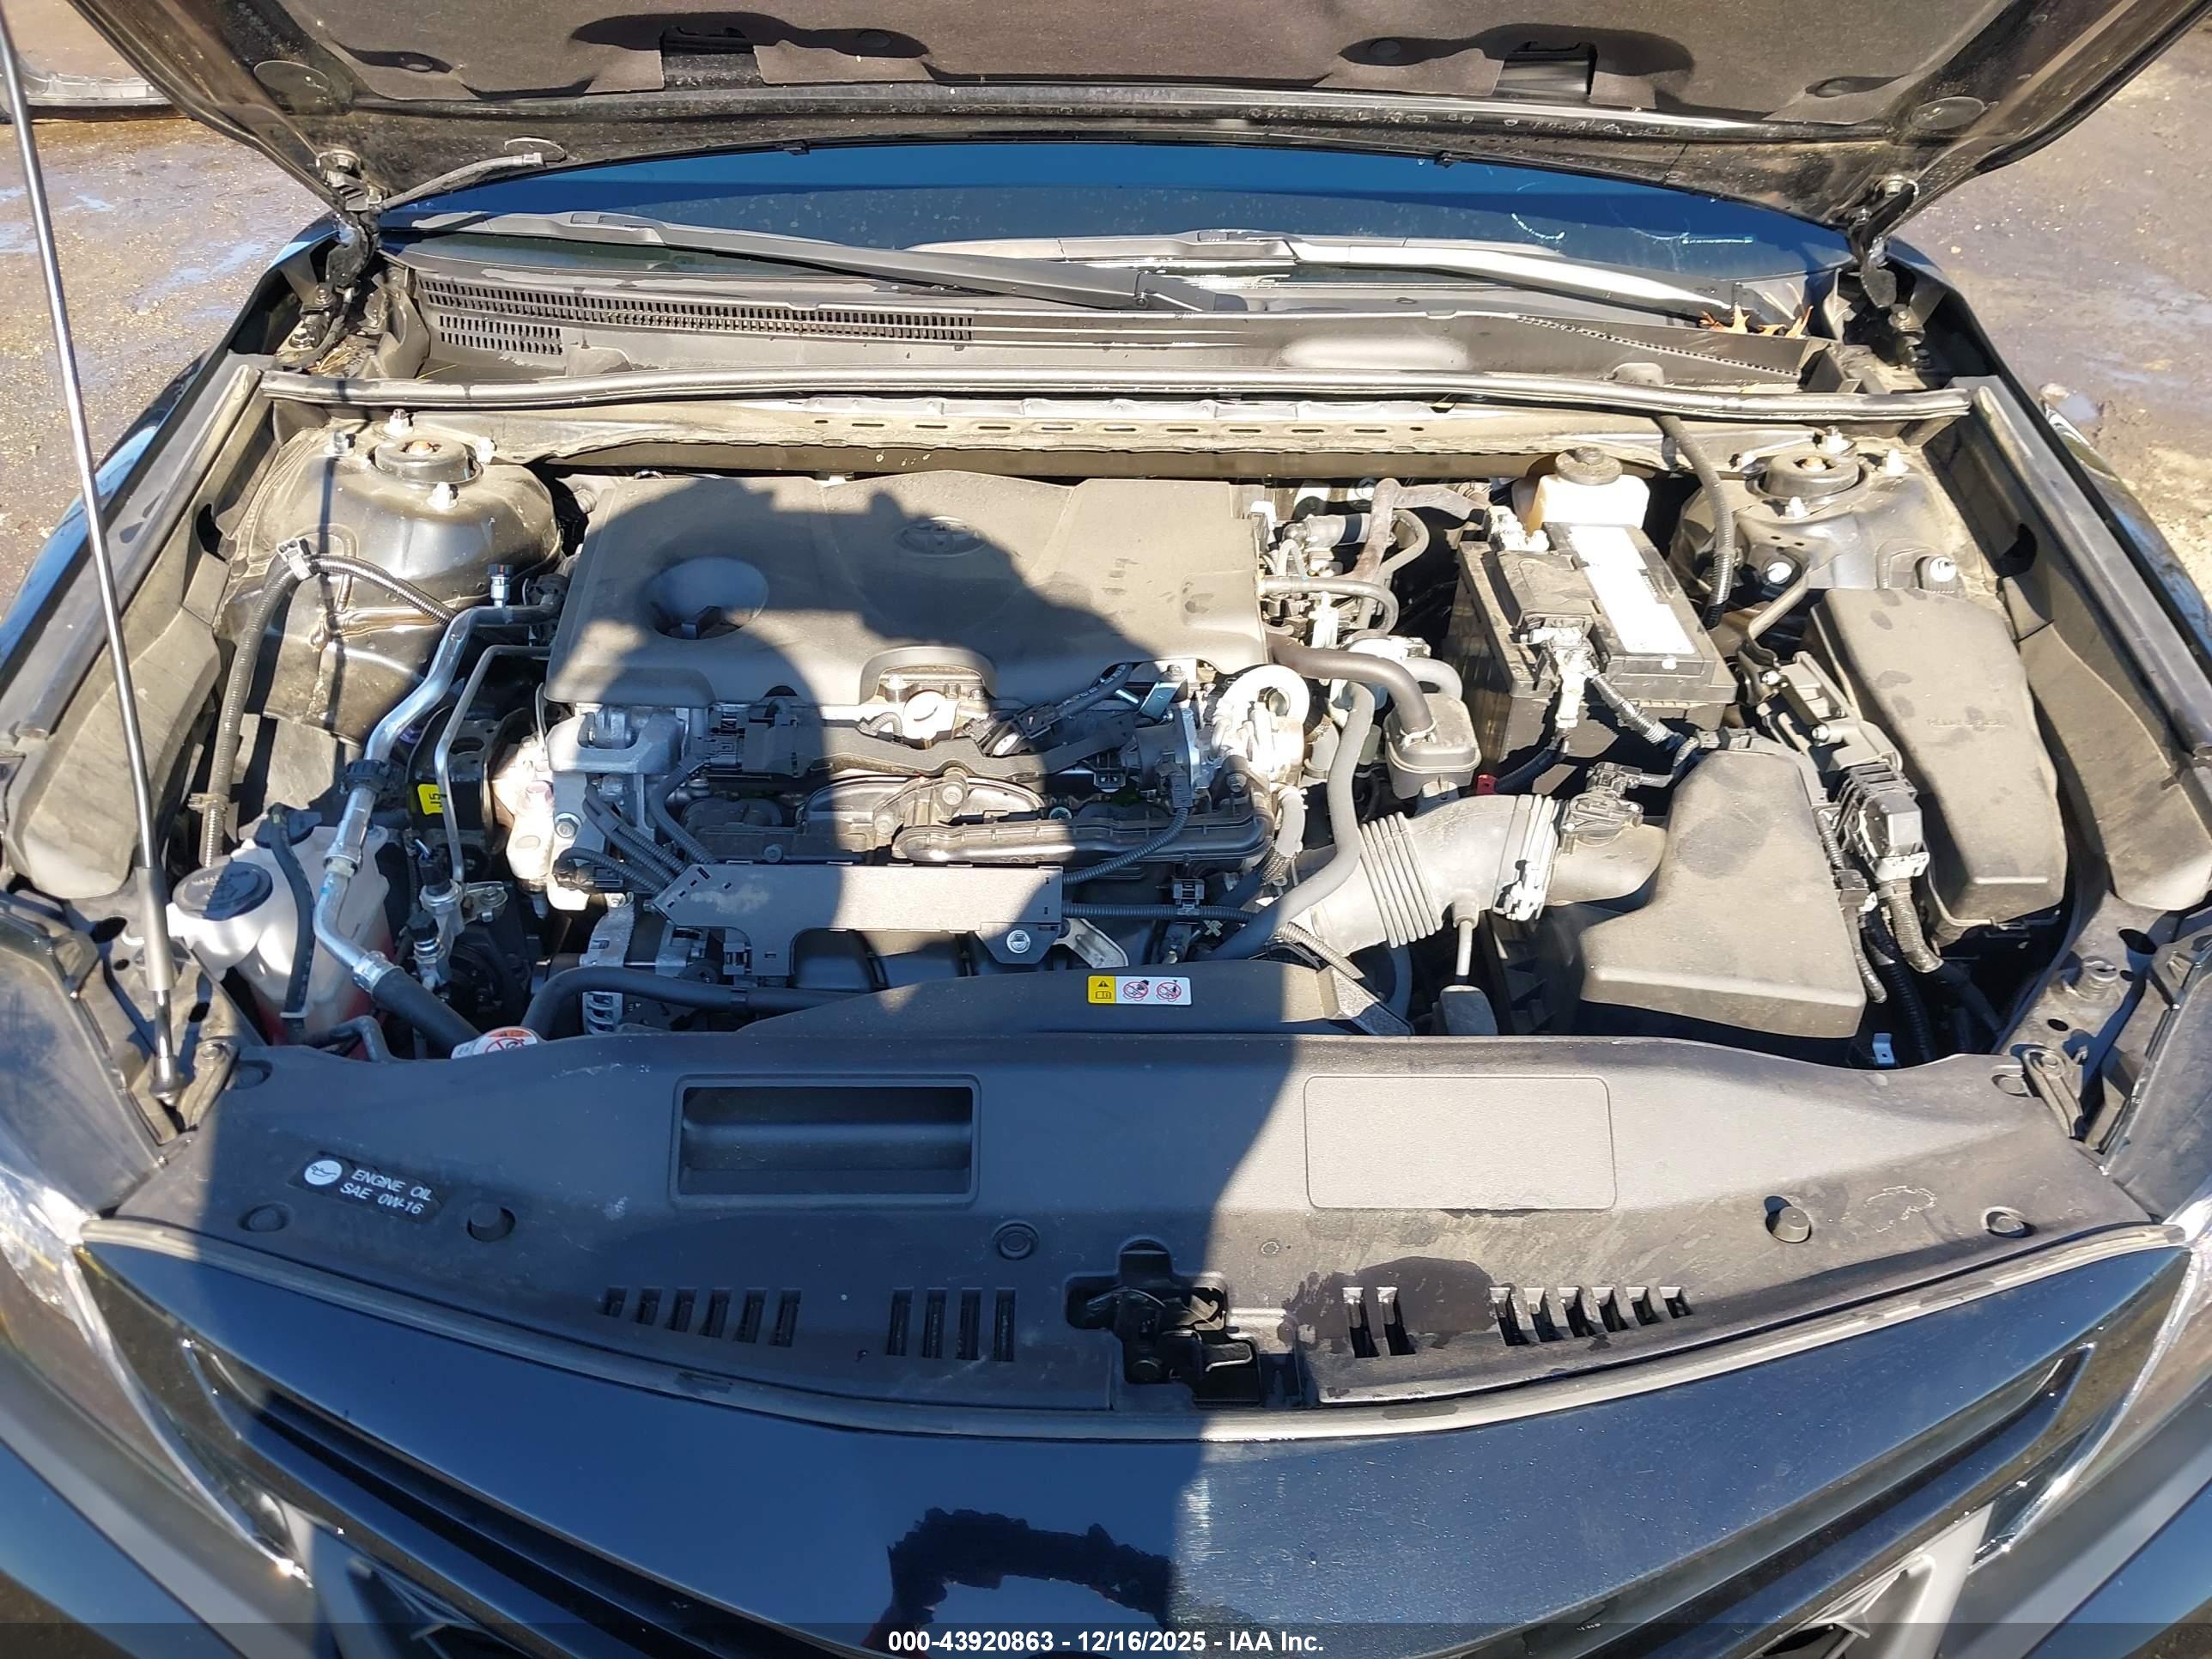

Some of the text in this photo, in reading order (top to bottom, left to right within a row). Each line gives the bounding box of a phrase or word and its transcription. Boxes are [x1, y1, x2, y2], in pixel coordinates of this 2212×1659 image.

[340, 1183, 424, 1214] SAE 0W-16
[351, 1169, 433, 1201] ENGINE OIL
